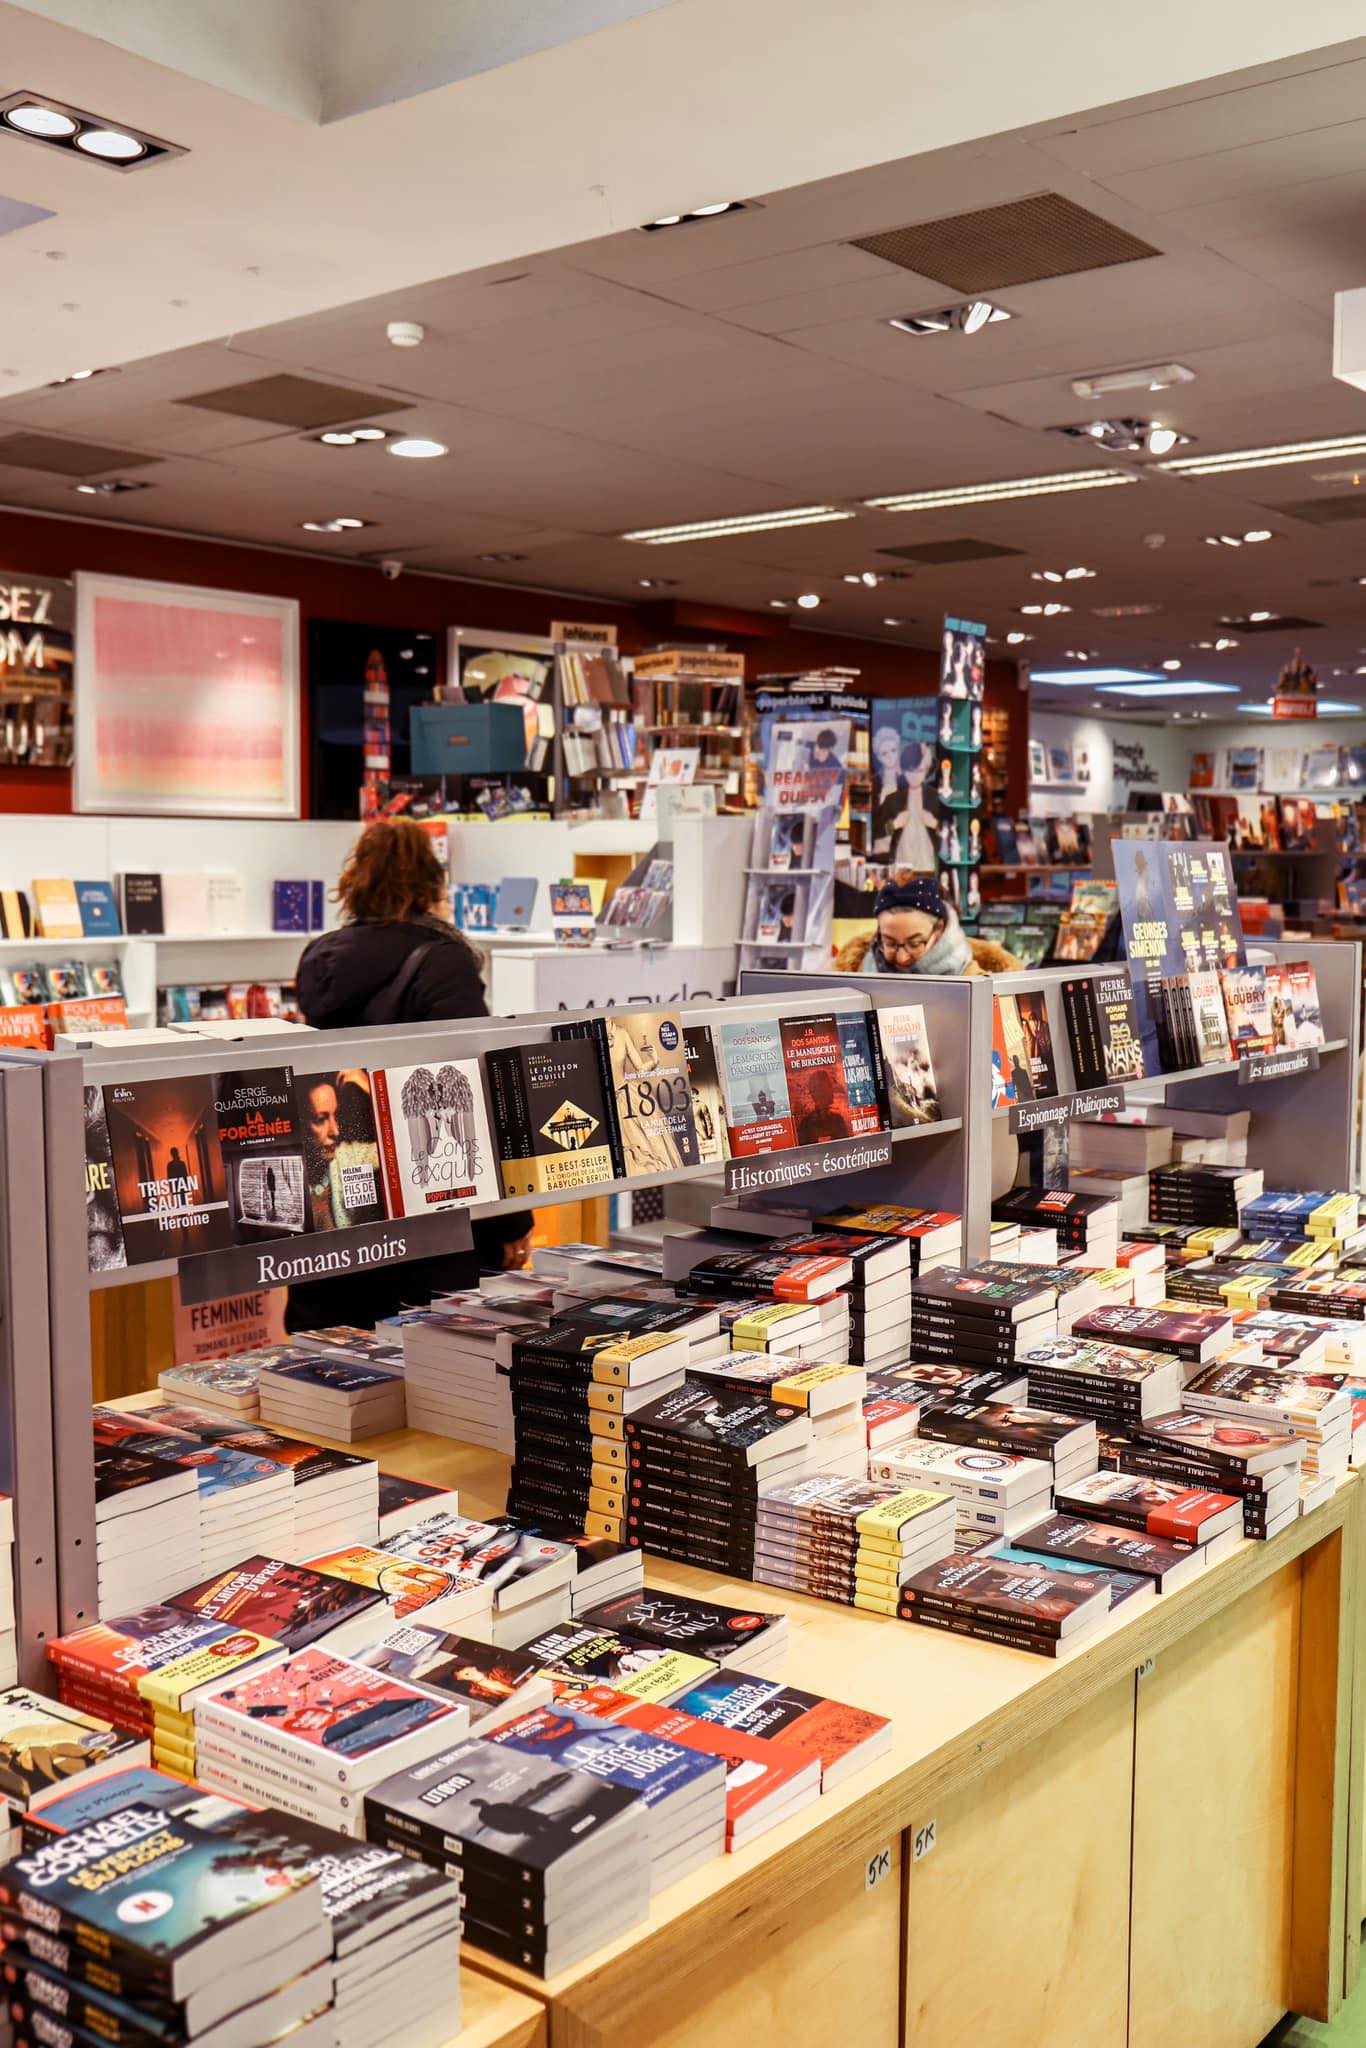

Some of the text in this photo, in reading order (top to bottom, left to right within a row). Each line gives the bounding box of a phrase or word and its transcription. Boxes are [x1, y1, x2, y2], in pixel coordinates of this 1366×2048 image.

[772, 769, 839, 788] REALITY
[778, 788, 829, 806] QUEST
[1132, 921, 1168, 941] GEORGES
[1128, 939, 1168, 959] SIMENON
[1100, 978, 1126, 992] PIERRE
[1227, 990, 1266, 1007] LOUBRY
[746, 1034, 772, 1044] SANTOS
[791, 1035, 830, 1047] DOS SANTOS
[786, 1044, 837, 1058] LE MANUSCRIT
[529, 1063, 578, 1075] LE POISSON
[791, 1055, 836, 1069] DE BIRKENAU
[233, 1085, 269, 1100] SERGE
[616, 1076, 691, 1120] 1803
[213, 1094, 289, 1113] QUADRUPPANI
[1017, 1104, 1069, 1131] Espionnage
[1075, 1095, 1120, 1116] Politiques
[218, 1116, 293, 1141] FORCENÉE
[245, 1111, 264, 1126] LA
[410, 1136, 480, 1163] Le Corps
[410, 1155, 485, 1188] exquis
[545, 1155, 608, 1175] LE BEST-SELLER
[730, 1161, 813, 1192] Historiques
[822, 1146, 890, 1172] ésotériques
[137, 1174, 200, 1198] TRISTAN
[343, 1172, 373, 1182] COUTURIER
[547, 1172, 611, 1191] BABYLON BERLIN
[344, 1182, 374, 1196] FILS DE
[147, 1191, 195, 1213] SAULE
[345, 1192, 376, 1208] FEMME
[158, 1211, 210, 1232] Héroïne
[256, 1234, 408, 1284] Romans noirs
[417, 1523, 486, 1558] GIRLS
[428, 1549, 464, 1569] ON
[937, 1561, 984, 1589] FOUASSIER
[197, 1571, 256, 1621] LES SAISONS
[626, 1600, 677, 1627] SUR
[651, 1609, 689, 1631] LES
[666, 1612, 720, 1640] RAILS
[111, 1623, 188, 1659] CAROLINE
[527, 1632, 567, 1654] ALAIN
[310, 1662, 349, 1682] BOYLE
[573, 1657, 590, 1668] ET
[637, 1685, 652, 1696] Un
[719, 1683, 774, 1728] JAPRISOT
[561, 1744, 600, 1766] LA
[621, 1742, 686, 1780] JURÉE
[15, 1807, 151, 1875] MICHAEL
[27, 1809, 173, 1887] CONNELLY
[915, 1823, 935, 1857] 5K
[115, 1834, 186, 1874] PLOMB
[66, 1867, 91, 1887] LE
[868, 1850, 890, 1885] 5K
